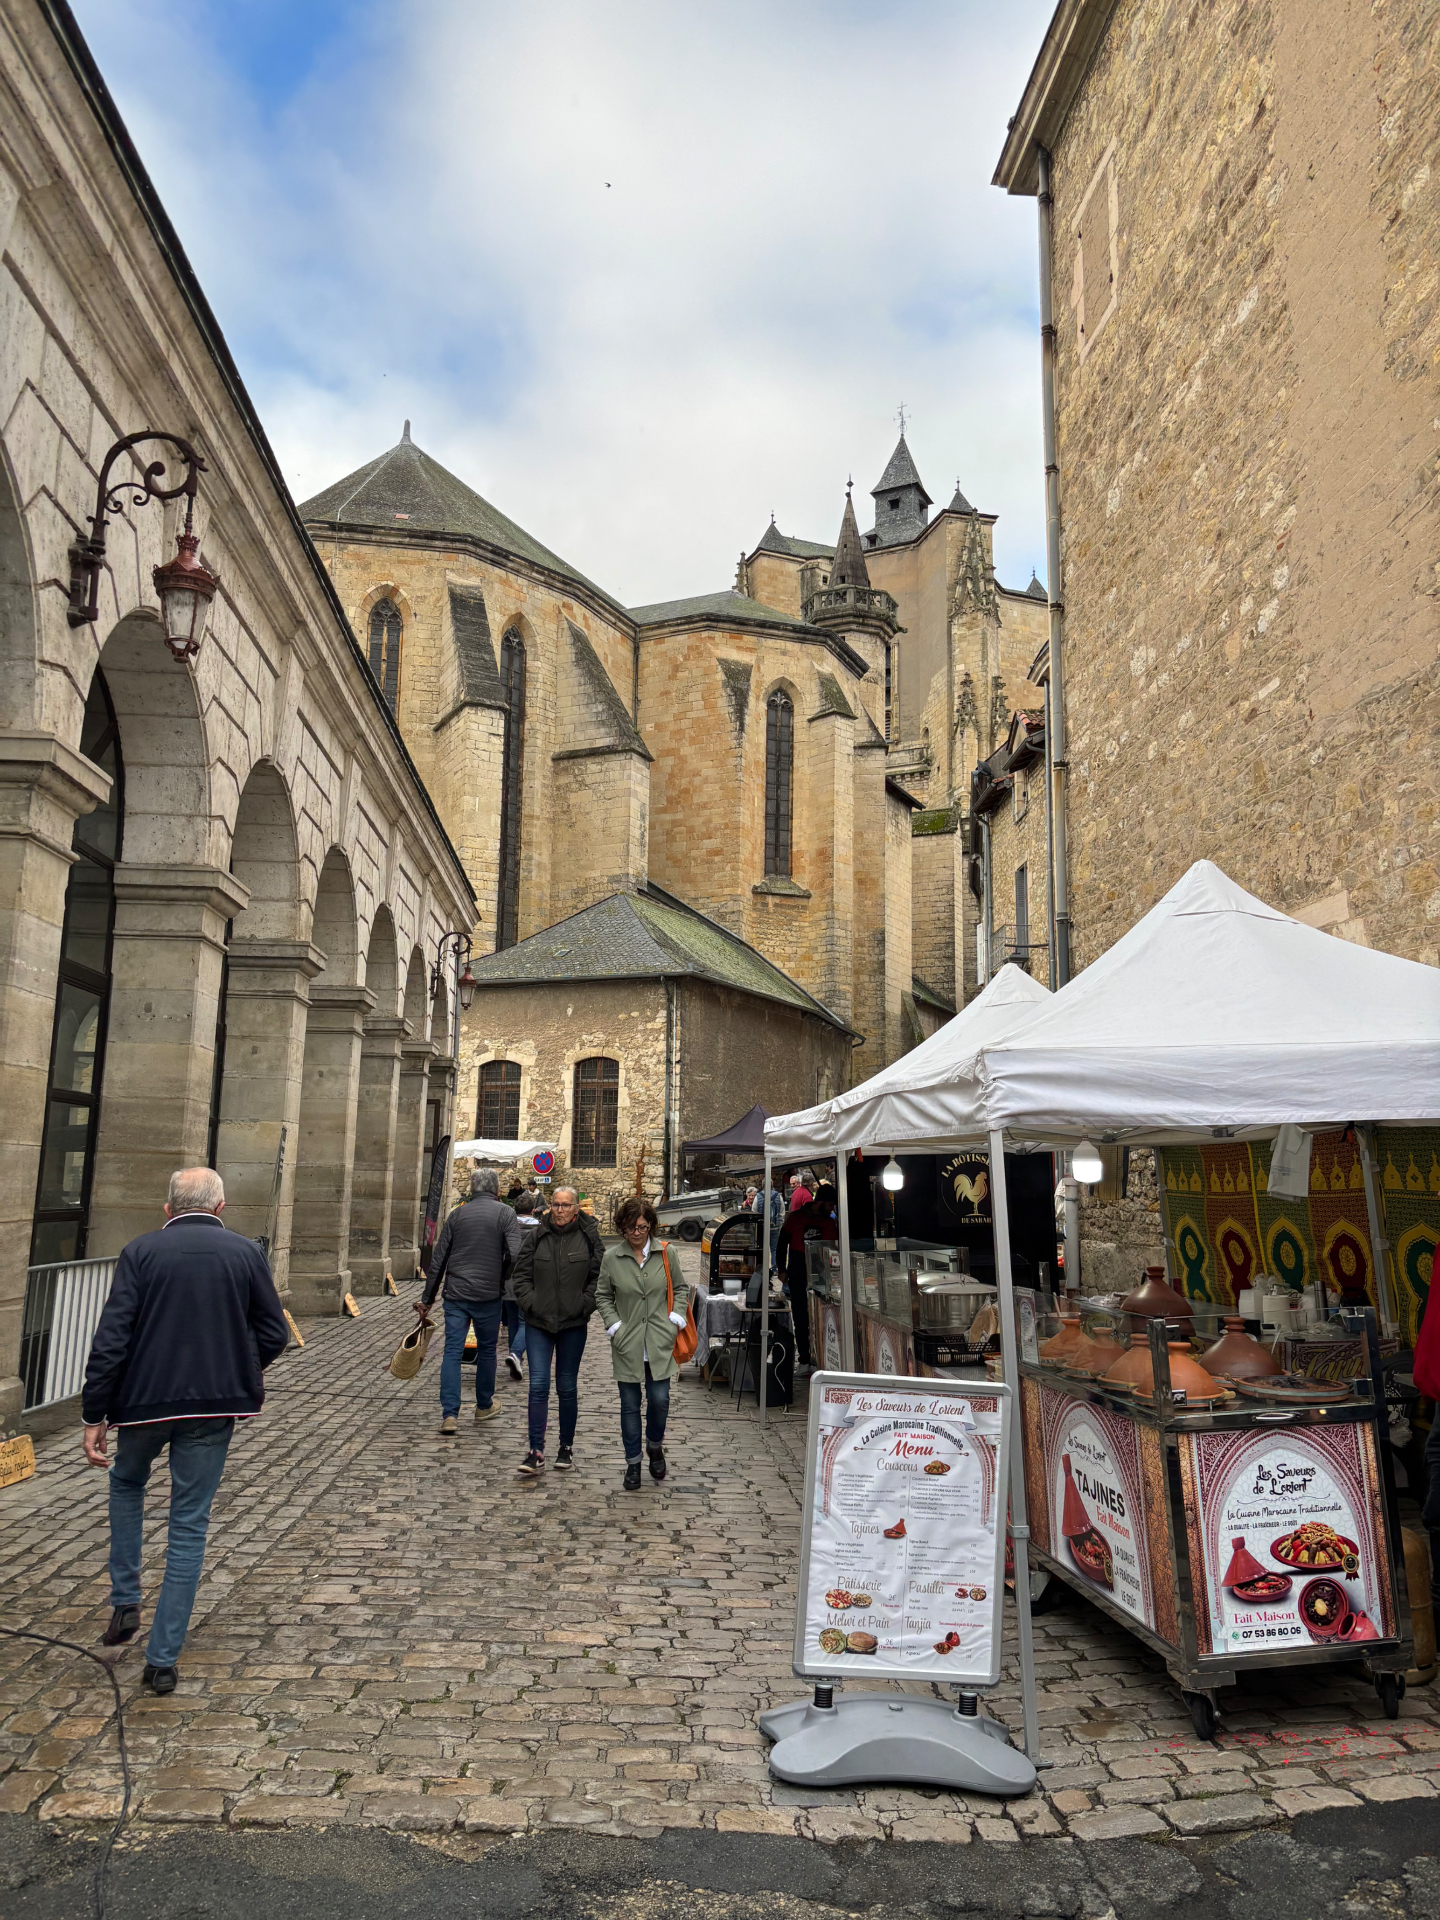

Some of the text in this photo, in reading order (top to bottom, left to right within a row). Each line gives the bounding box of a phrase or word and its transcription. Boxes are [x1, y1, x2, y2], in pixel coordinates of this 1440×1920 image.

[941, 1165, 954, 1178] LA
[856, 1397, 872, 1411] Les
[875, 1398, 912, 1413] Saveurs
[914, 1401, 926, 1413] de
[861, 1420, 964, 1450] La Cuisine Marocaine Traditionnelle
[888, 1440, 934, 1459] Menu
[876, 1458, 918, 1473] Couscous
[1256, 1463, 1316, 1481] Les Saveurs
[1075, 1468, 1125, 1517] TAJINES
[1252, 1480, 1264, 1495] de
[1227, 1502, 1342, 1520] La Cuisine Marocaine Traditionnelle
[850, 1521, 880, 1539] Tajines
[1096, 1505, 1130, 1540] Fait Maison
[1114, 1544, 1119, 1556] LA
[837, 1575, 882, 1592] Pâtisserie
[909, 1580, 945, 1595] Pastilla
[858, 1616, 867, 1627] et
[868, 1615, 890, 1629] Pain
[904, 1616, 932, 1635] Tanjia
[1234, 1611, 1295, 1624] Fait Maison
[1242, 1626, 1301, 1638] 07 53 86 80 06
[885, 1638, 894, 1646] 2€
